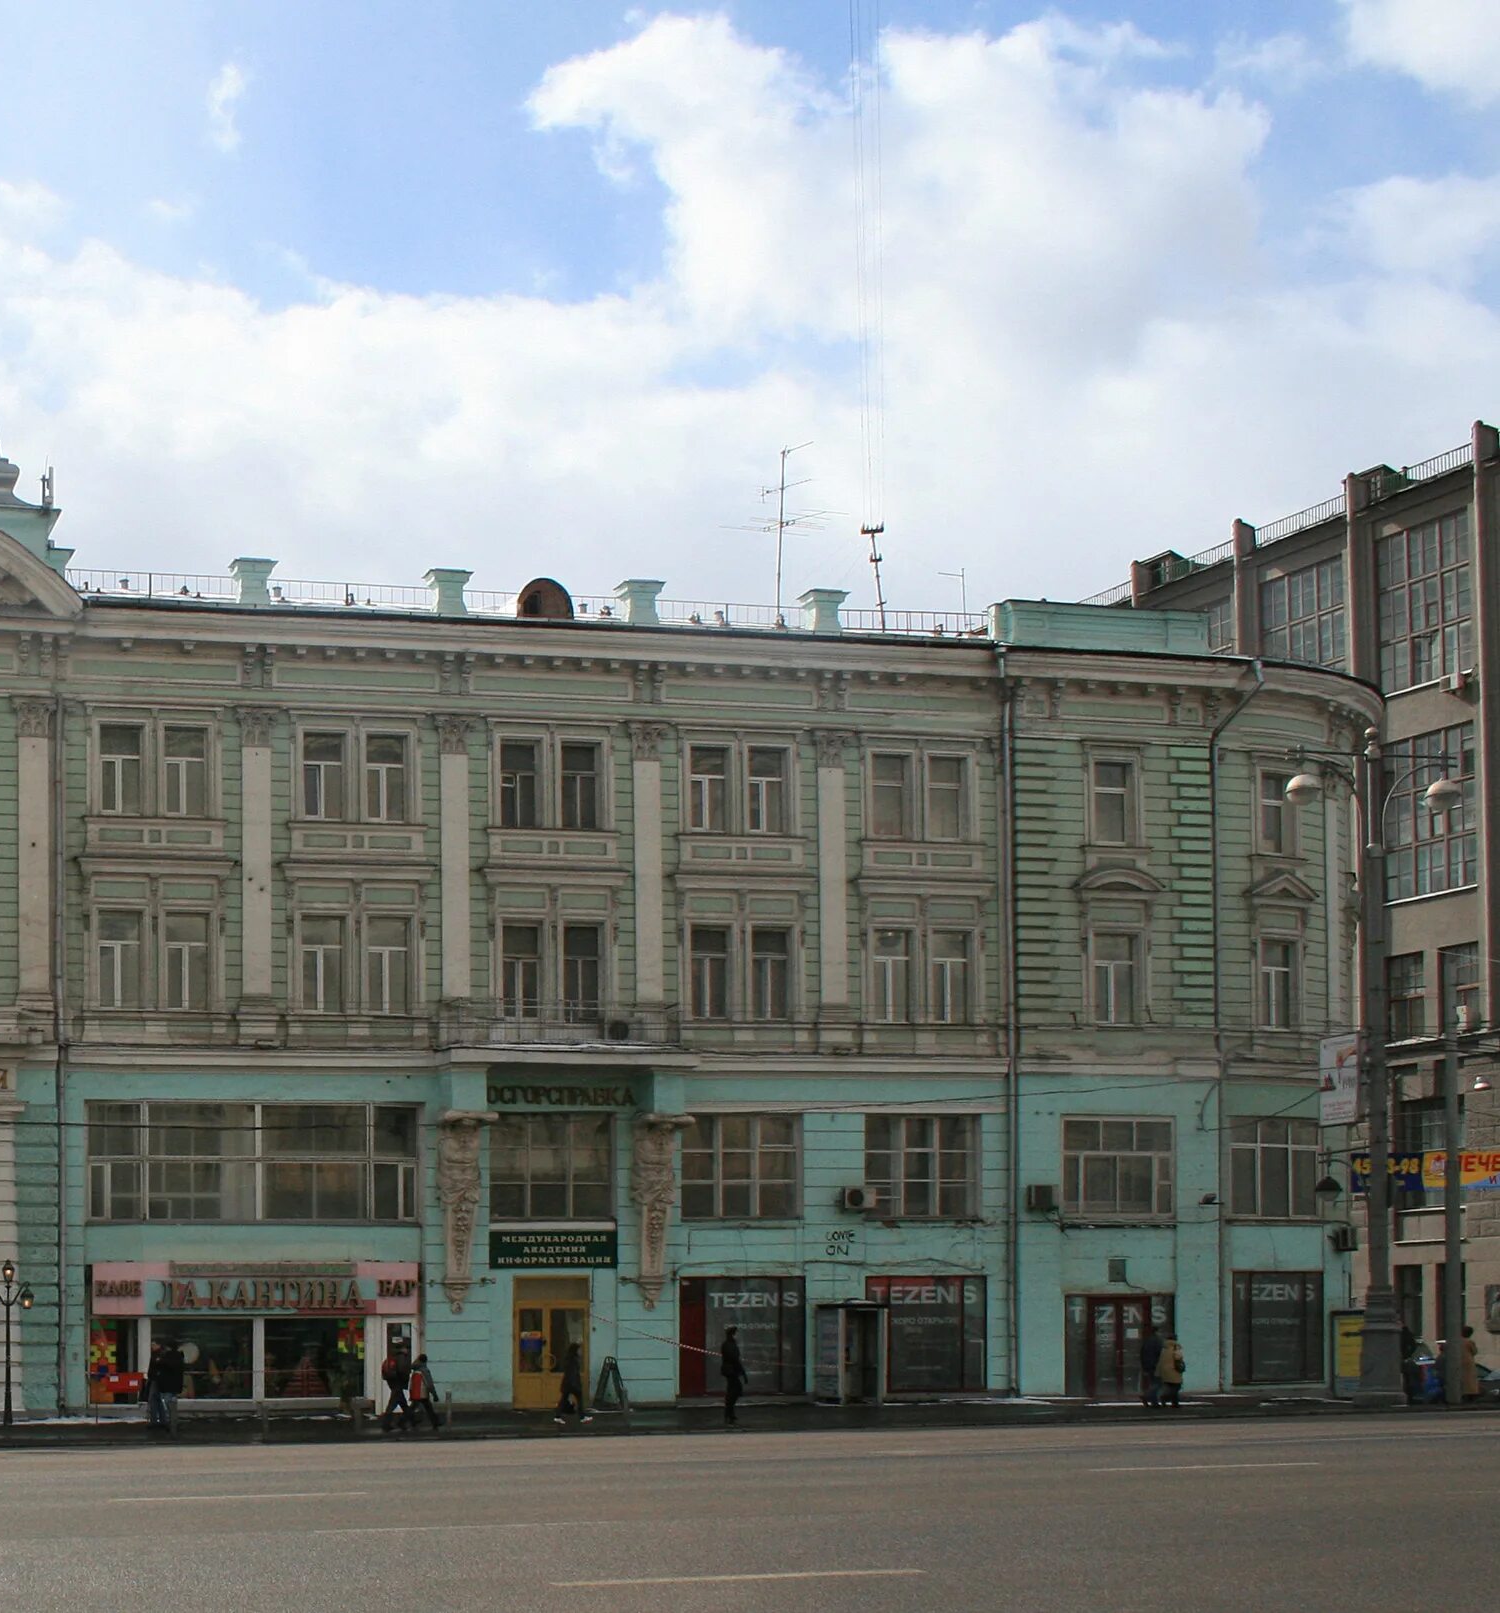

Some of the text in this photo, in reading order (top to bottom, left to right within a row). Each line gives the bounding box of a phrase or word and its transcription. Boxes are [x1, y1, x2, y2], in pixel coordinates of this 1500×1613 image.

[487, 1087, 636, 1106] ОСГОРСПРАВКА
[1458, 1155, 1500, 1172] ЕЧЕ
[826, 1244, 849, 1256] ON
[95, 1280, 142, 1296] КАФЕ
[208, 1280, 365, 1310] КАНТИНА
[377, 1279, 417, 1297] БАР
[870, 1285, 977, 1304] TEZENIS
[1236, 1283, 1315, 1301] TEZENS
[709, 1292, 799, 1308] TEZENS
